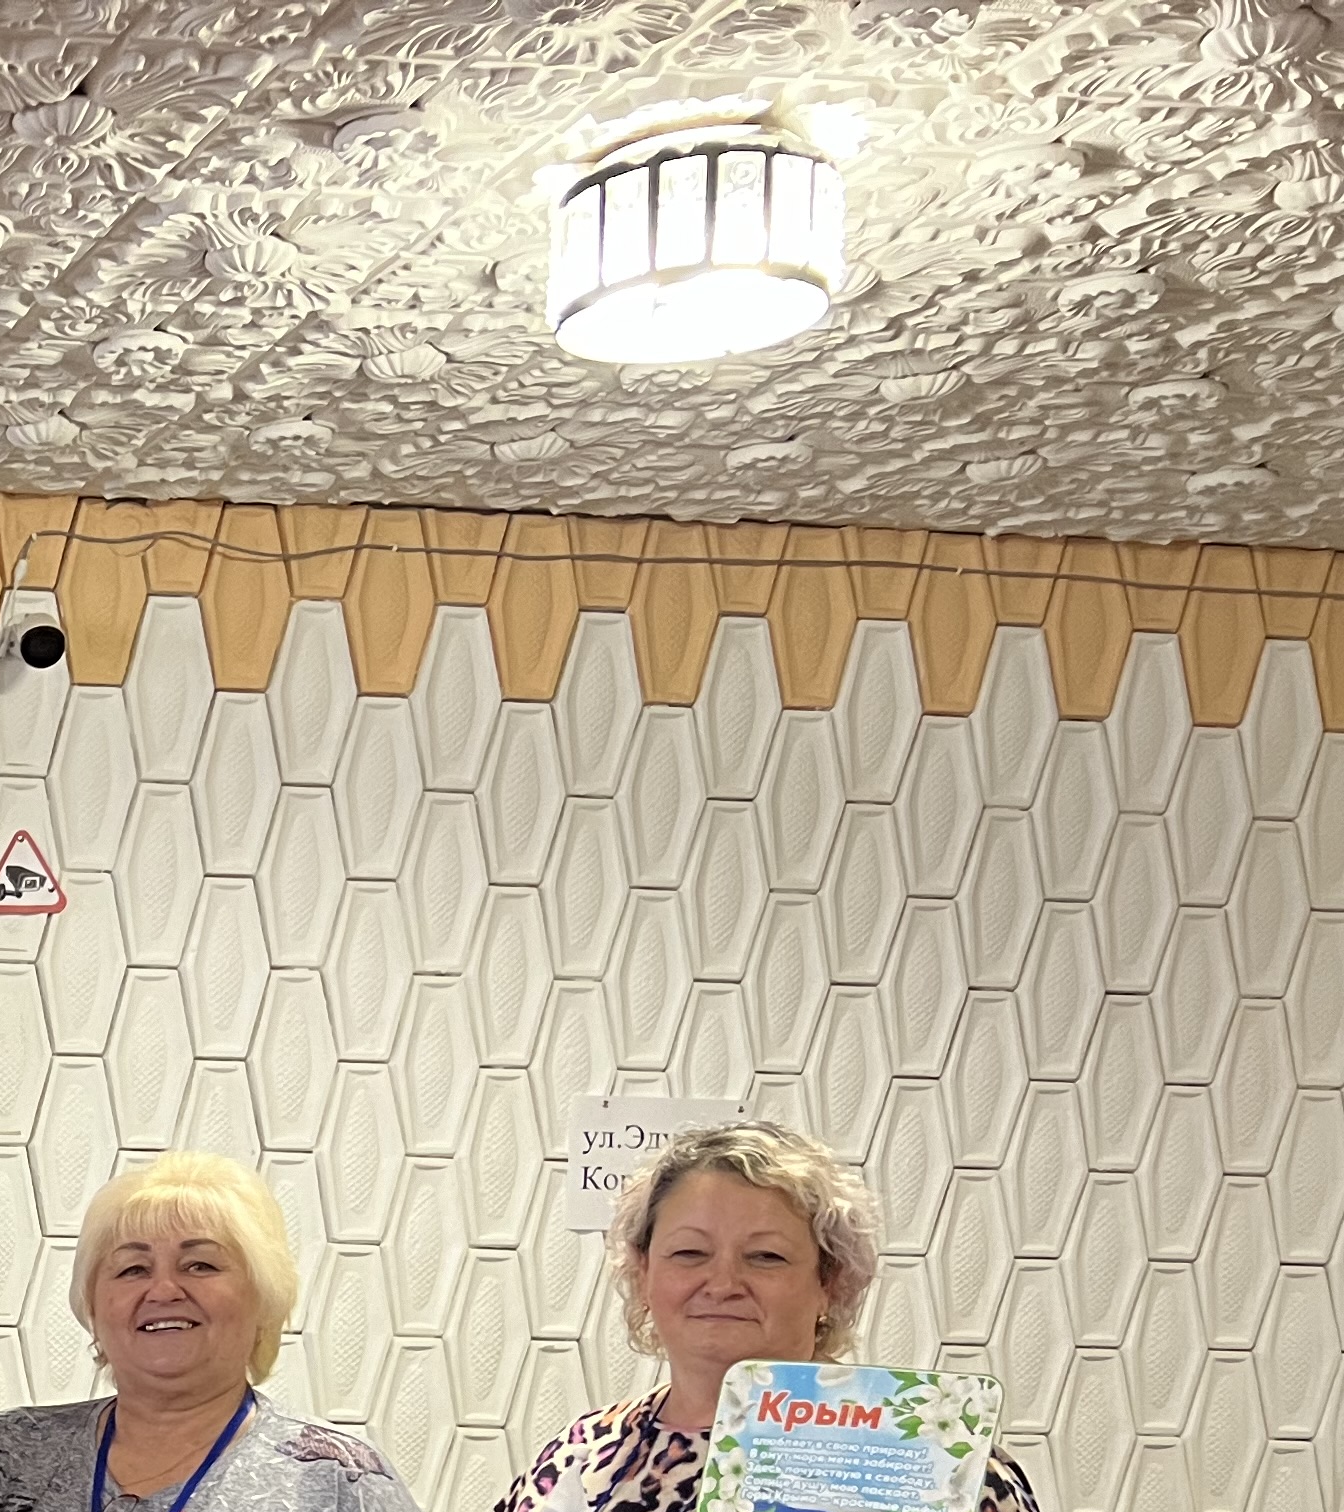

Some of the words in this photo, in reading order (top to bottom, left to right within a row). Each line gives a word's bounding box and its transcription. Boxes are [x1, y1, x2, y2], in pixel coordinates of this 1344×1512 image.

[757, 1391, 883, 1432] Крым
[749, 1448, 758, 1458] В
[760, 1452, 789, 1465] омут
[793, 1453, 824, 1464] моря
[828, 1456, 860, 1465] меня
[826, 1442, 860, 1452] свою
[863, 1445, 927, 1460] природу!
[746, 1462, 782, 1473] Здесь
[785, 1466, 862, 1480] почувствую
[745, 1475, 791, 1488] Солнце
[793, 1480, 827, 1492] душу
[830, 1484, 859, 1493] мою
[741, 1489, 772, 1503] Горы
[774, 1490, 817, 1503] Крыма
[833, 1498, 899, 1511] красивые
